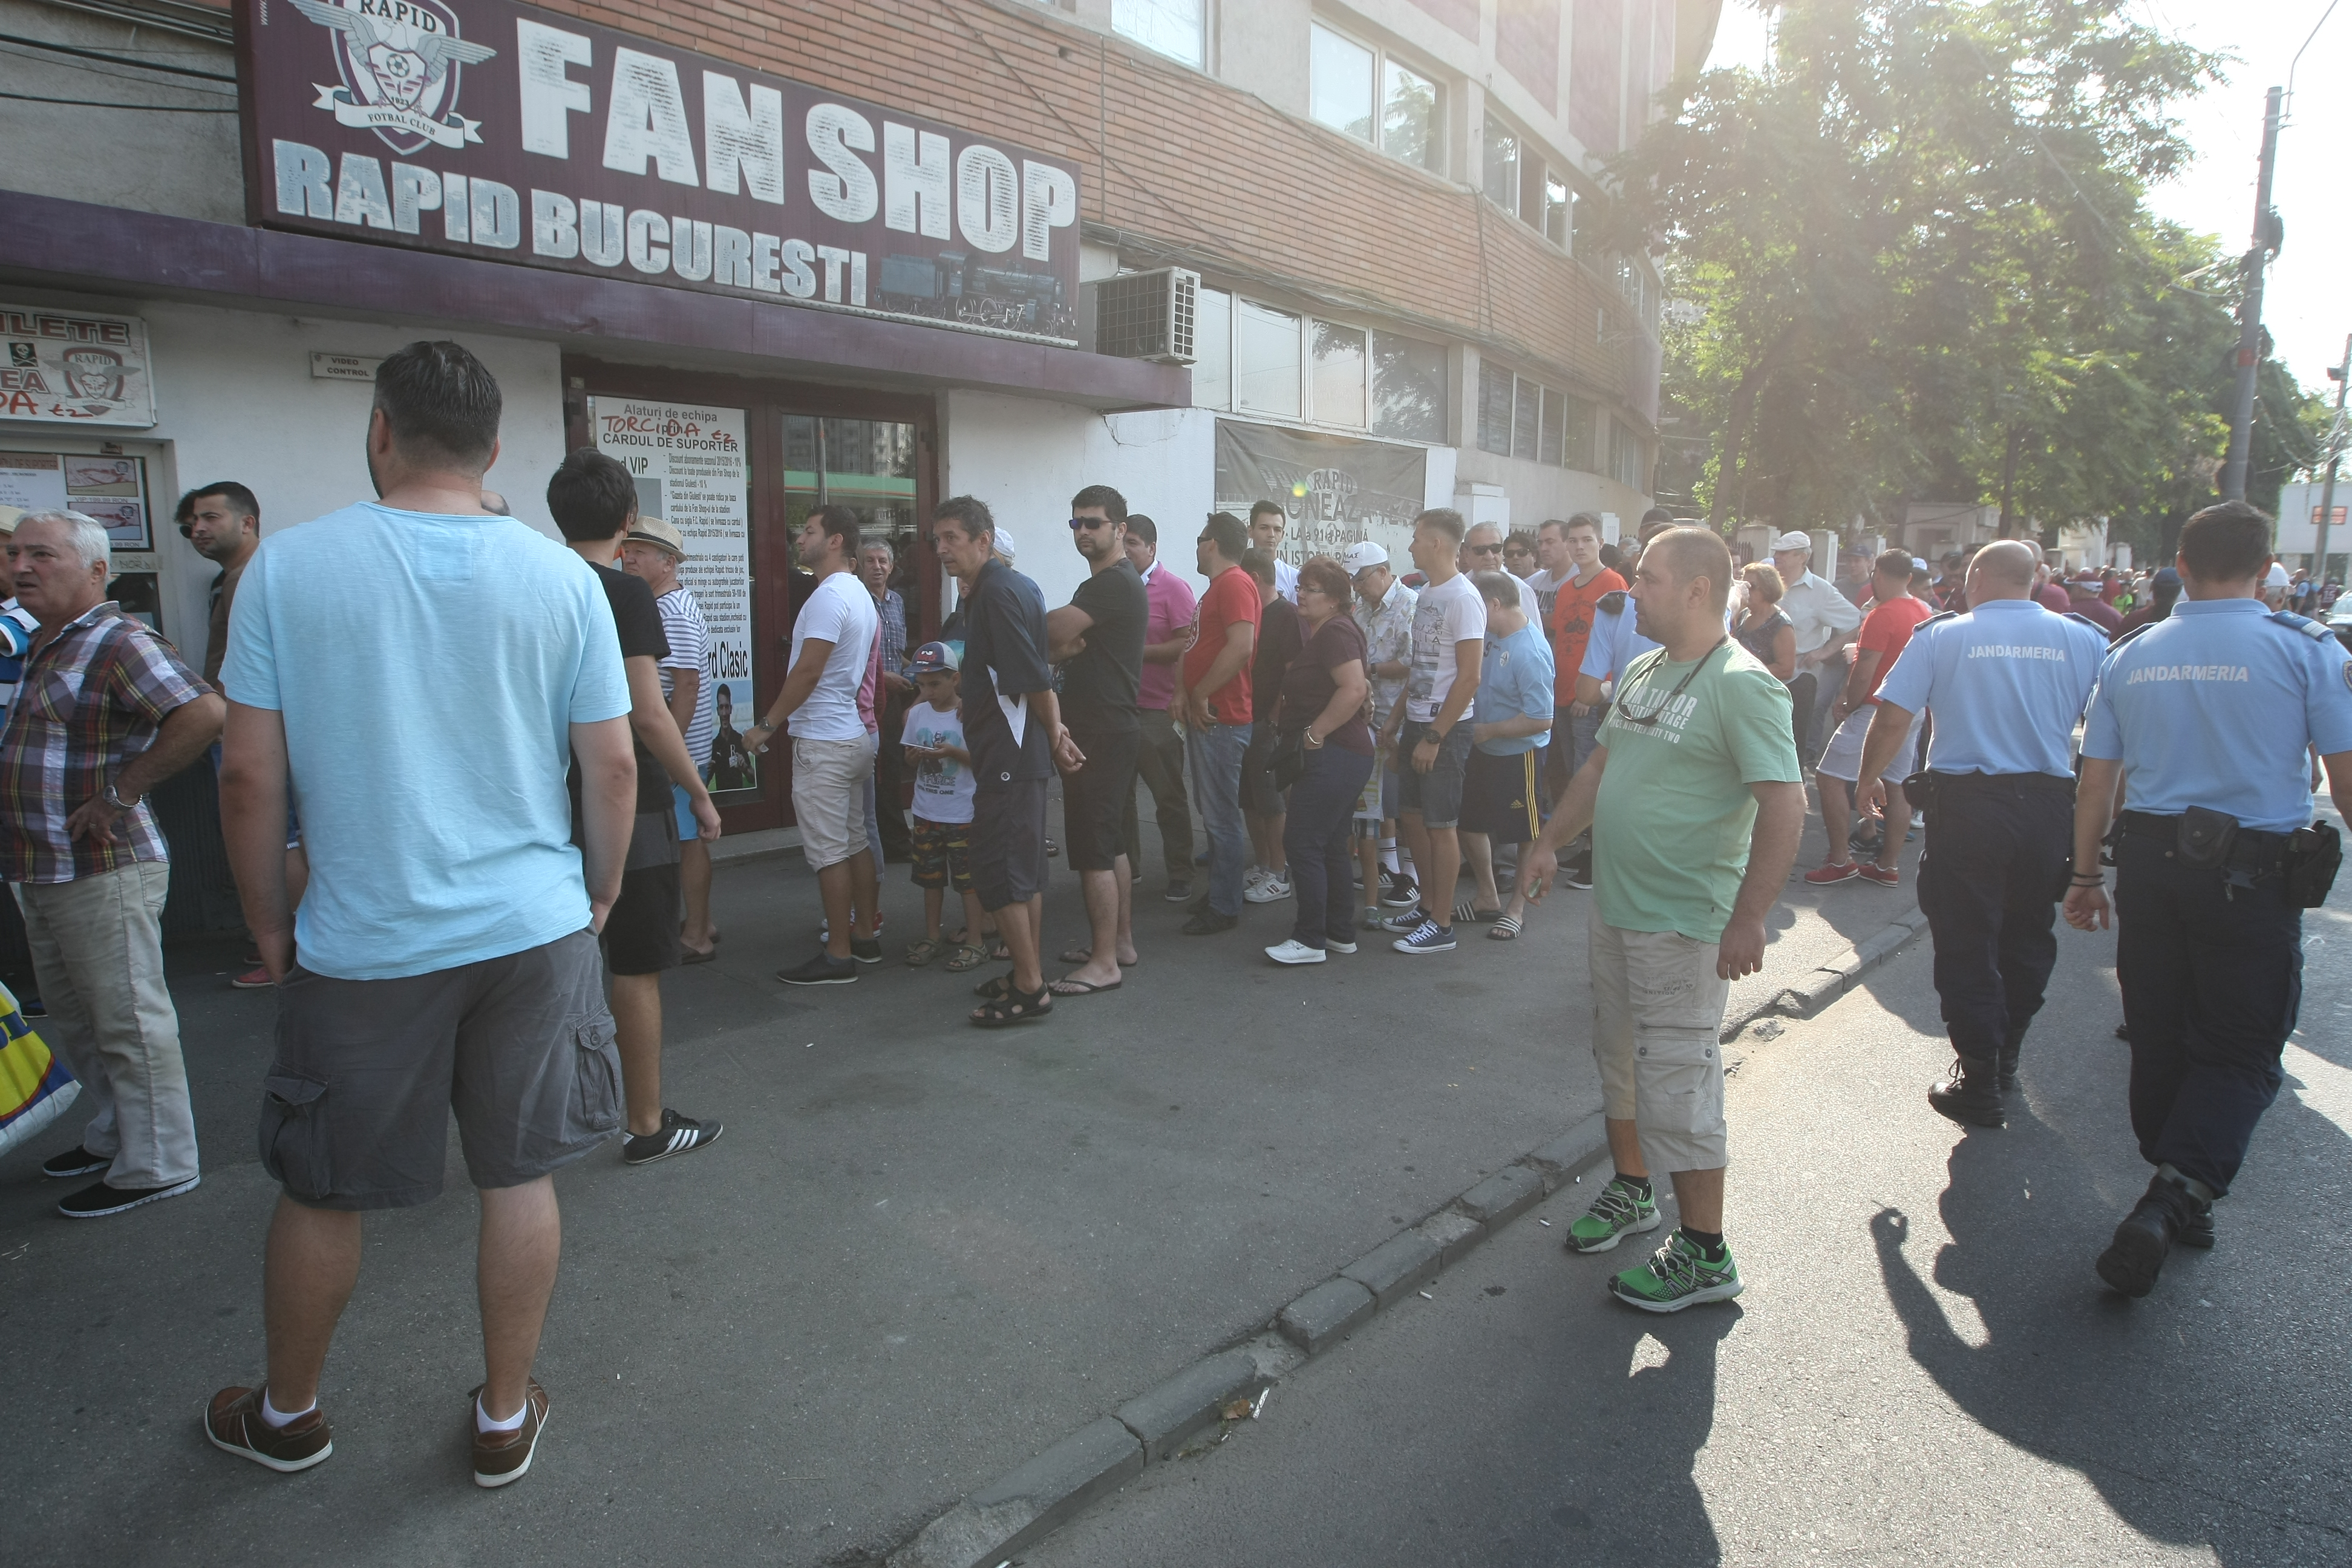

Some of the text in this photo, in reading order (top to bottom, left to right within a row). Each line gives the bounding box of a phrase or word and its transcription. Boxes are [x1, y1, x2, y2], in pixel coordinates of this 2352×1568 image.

[359, 0, 437, 33] RAPID
[391, 96, 410, 106] 1923
[367, 113, 437, 136] FOTBAL CLUB
[516, 17, 1076, 262] FAN SHOP
[272, 138, 867, 307] RAPID BUCURESTI
[74, 354, 112, 365] RAPID
[331, 357, 359, 365] VIDEO
[327, 367, 370, 376] CONTROL
[665, 408, 679, 419] de
[682, 411, 718, 423] echipa
[603, 433, 739, 452] CARDUL DE SUPORTER
[630, 457, 648, 474] VIP
[1313, 471, 1353, 494] RAPID
[1313, 528, 1324, 541] 91
[708, 641, 748, 679] rd Clasic
[1967, 645, 2065, 662] JANDARMERIA
[2126, 665, 2249, 685] JANDARMERIA
[1656, 710, 1689, 730] NTAGE
[1664, 730, 1681, 744] TWO
[926, 776, 956, 786] FORCE
